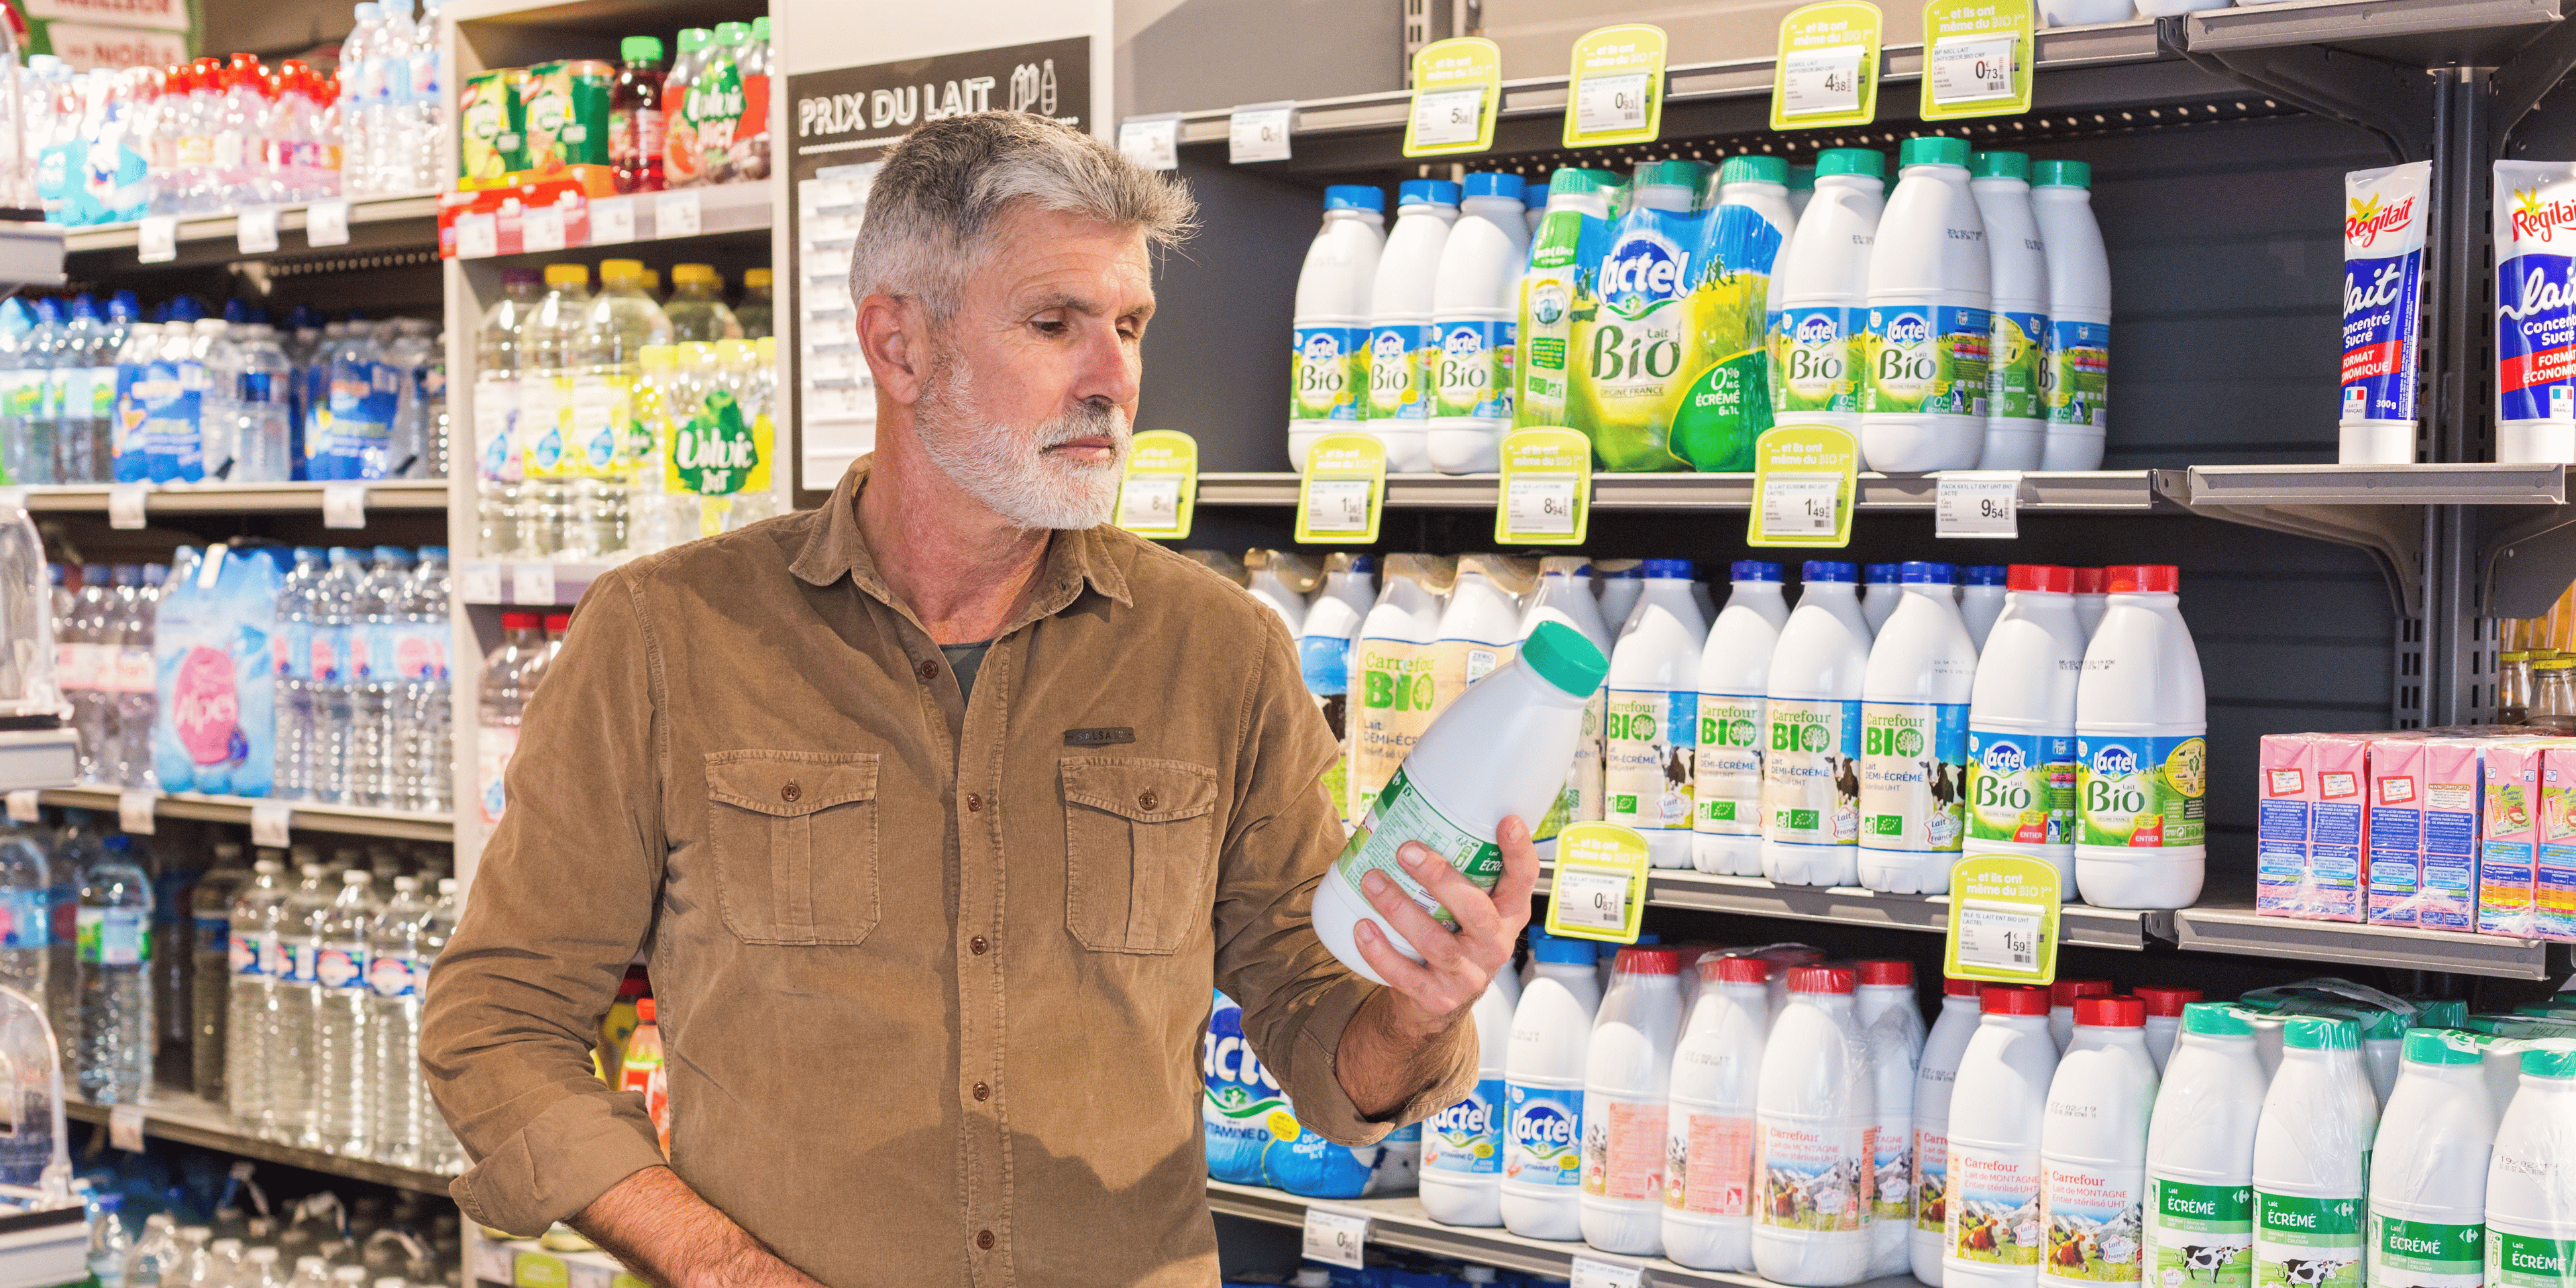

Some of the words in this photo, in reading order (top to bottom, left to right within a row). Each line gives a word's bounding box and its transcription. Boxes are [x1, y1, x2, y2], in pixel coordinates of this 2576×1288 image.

[1951, 9, 1961, 19] et
[1963, 7, 1974, 17] ils
[1976, 5, 1995, 16] ont
[1830, 20, 1847, 31] ont
[1939, 20, 1973, 32] même
[1975, 19, 1989, 29] du
[1992, 15, 2012, 28] BIO
[1827, 33, 1841, 42] du
[799, 92, 866, 138] PRIX
[872, 86, 917, 128] DU
[924, 76, 995, 121] LAIT
[2345, 197, 2414, 248] Régilait
[2344, 264, 2400, 319] lait
[2343, 311, 2390, 338] oncentré
[1648, 329, 1668, 339] Lait
[2345, 327, 2373, 349] Sucré
[2542, 326, 2575, 345] Sucré
[1592, 325, 1680, 380] Bio
[2343, 350, 2375, 369] FORMAT
[2538, 350, 2576, 367] FORMAT
[1789, 350, 1842, 379] Bio
[1879, 349, 1936, 380] Bio
[1300, 365, 1343, 390] Bio
[1371, 364, 1408, 390] Bio
[1440, 360, 1486, 388] Bio
[1629, 386, 1664, 396] FRANCE
[1695, 389, 1740, 407] ÉCRÉMÉ
[2376, 400, 2397, 410] 300g
[1805, 442, 1823, 452] ont
[1770, 454, 1802, 464] même
[1803, 454, 1817, 464] du
[1702, 704, 1758, 718] Carrefour
[1773, 709, 1831, 723] Carrefour
[1364, 720, 1381, 731] Lait
[1867, 713, 1925, 727] Carrefour
[1701, 717, 1756, 747] BIO
[1772, 722, 1830, 753] BIO
[1866, 727, 1925, 758] BIO
[1701, 759, 1756, 770] DEMI-ÉCRÉMÉ
[1772, 765, 1829, 777] DEMI-ÉCRÉMÉ
[1866, 762, 1876, 770] Lait
[1792, 778, 1807, 786] UHT
[1865, 771, 1924, 782] DEMI-ÉCRÉMÉ
[1976, 775, 2031, 809] Bio
[2087, 780, 2145, 812] Bio
[1837, 814, 1851, 822] Lait
[1931, 819, 1946, 828] Lait
[1931, 833, 1953, 842] France
[1978, 872, 1989, 881] et
[1991, 873, 2002, 883] ils
[2004, 874, 2023, 884] ont
[1967, 884, 2000, 895] même
[2002, 885, 2016, 896] du
[2019, 885, 2038, 897] BIO
[1770, 1128, 1819, 1142] Carrefour
[1792, 1142, 1839, 1154] MONTAGNE
[1965, 1157, 2018, 1173] Carrefour
[1965, 1170, 1977, 1179] Lait
[1979, 1172, 1988, 1181] de
[1990, 1174, 2039, 1184] MONTAGNE
[2053, 1171, 2106, 1187] Carrefour
[1965, 1179, 1985, 1190] Entier
[1986, 1182, 2019, 1193] stérilisé
[2020, 1185, 2037, 1193] UHT
[2053, 1185, 2064, 1193] Lait
[2066, 1186, 2075, 1194] de
[2076, 1188, 2127, 1198] MONTAGNE
[2053, 1194, 2072, 1204] Entier
[2074, 1197, 2106, 1208] stérilisé
[2107, 1199, 2125, 1208] UHT
[2167, 1195, 2216, 1215] ÉCRÉMÉ
[2267, 1209, 2316, 1228] ÉCRÉMÉ
[2390, 1235, 2441, 1255] ÉCRÉMÉ
[2512, 1252, 2567, 1271] ÉCRÉMÉ
[2051, 1264, 2061, 1275] 1L
